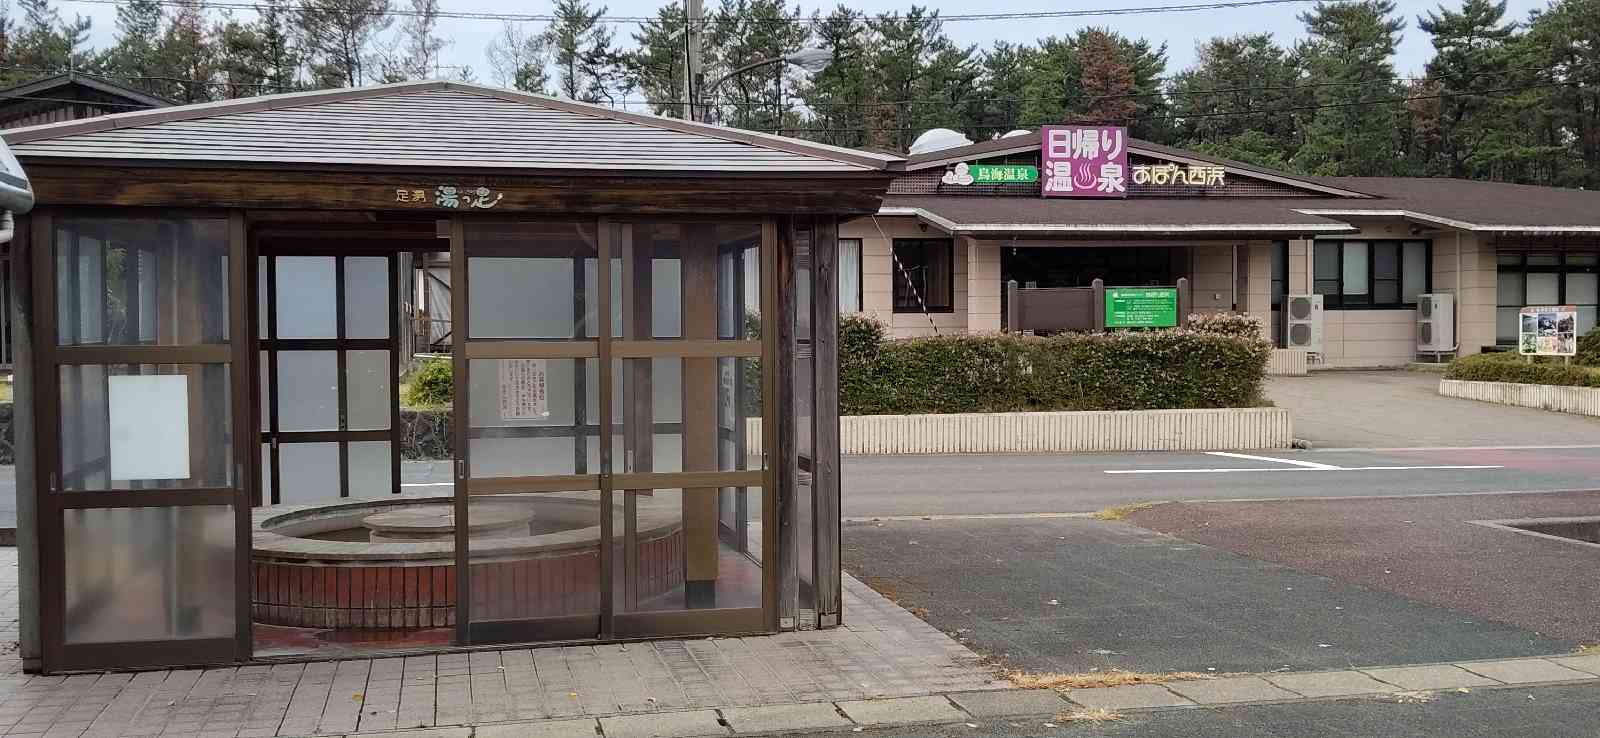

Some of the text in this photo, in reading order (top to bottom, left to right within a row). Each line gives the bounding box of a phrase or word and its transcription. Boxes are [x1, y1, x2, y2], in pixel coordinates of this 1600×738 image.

[1048, 128, 1122, 161] 日帰り
[977, 167, 1029, 181] 鳥海温泉
